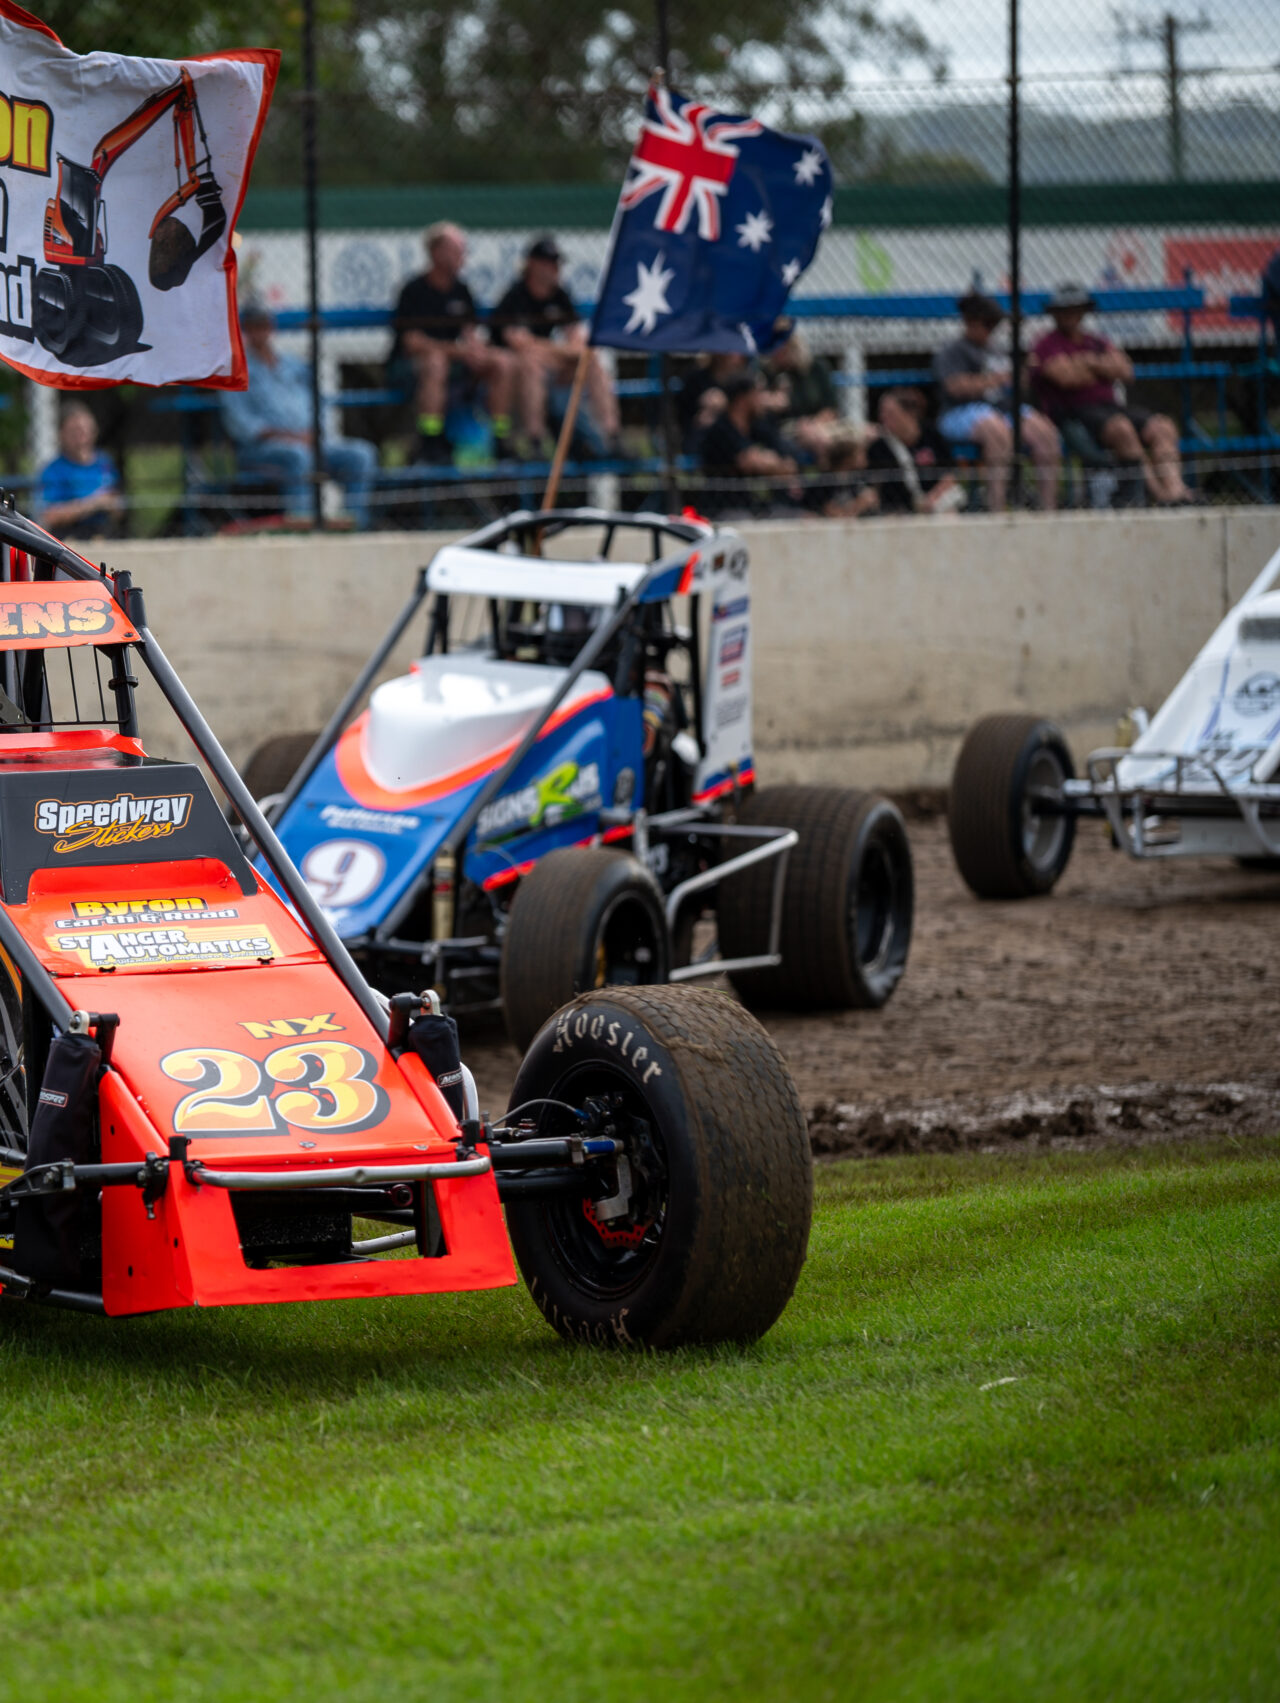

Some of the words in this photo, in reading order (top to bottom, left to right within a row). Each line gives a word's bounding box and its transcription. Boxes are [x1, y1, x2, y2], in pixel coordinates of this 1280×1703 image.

[38, 796, 188, 834] Speedway
[56, 814, 173, 852] Stickers
[302, 838, 387, 909] 9
[55, 911, 137, 929] Earth
[137, 909, 161, 924] &
[164, 908, 239, 921] Road
[74, 897, 205, 917] Byron
[58, 929, 187, 960] STANGER
[237, 1013, 346, 1040] NX
[553, 1008, 662, 1084] Hoosier
[160, 1041, 389, 1137] 23
